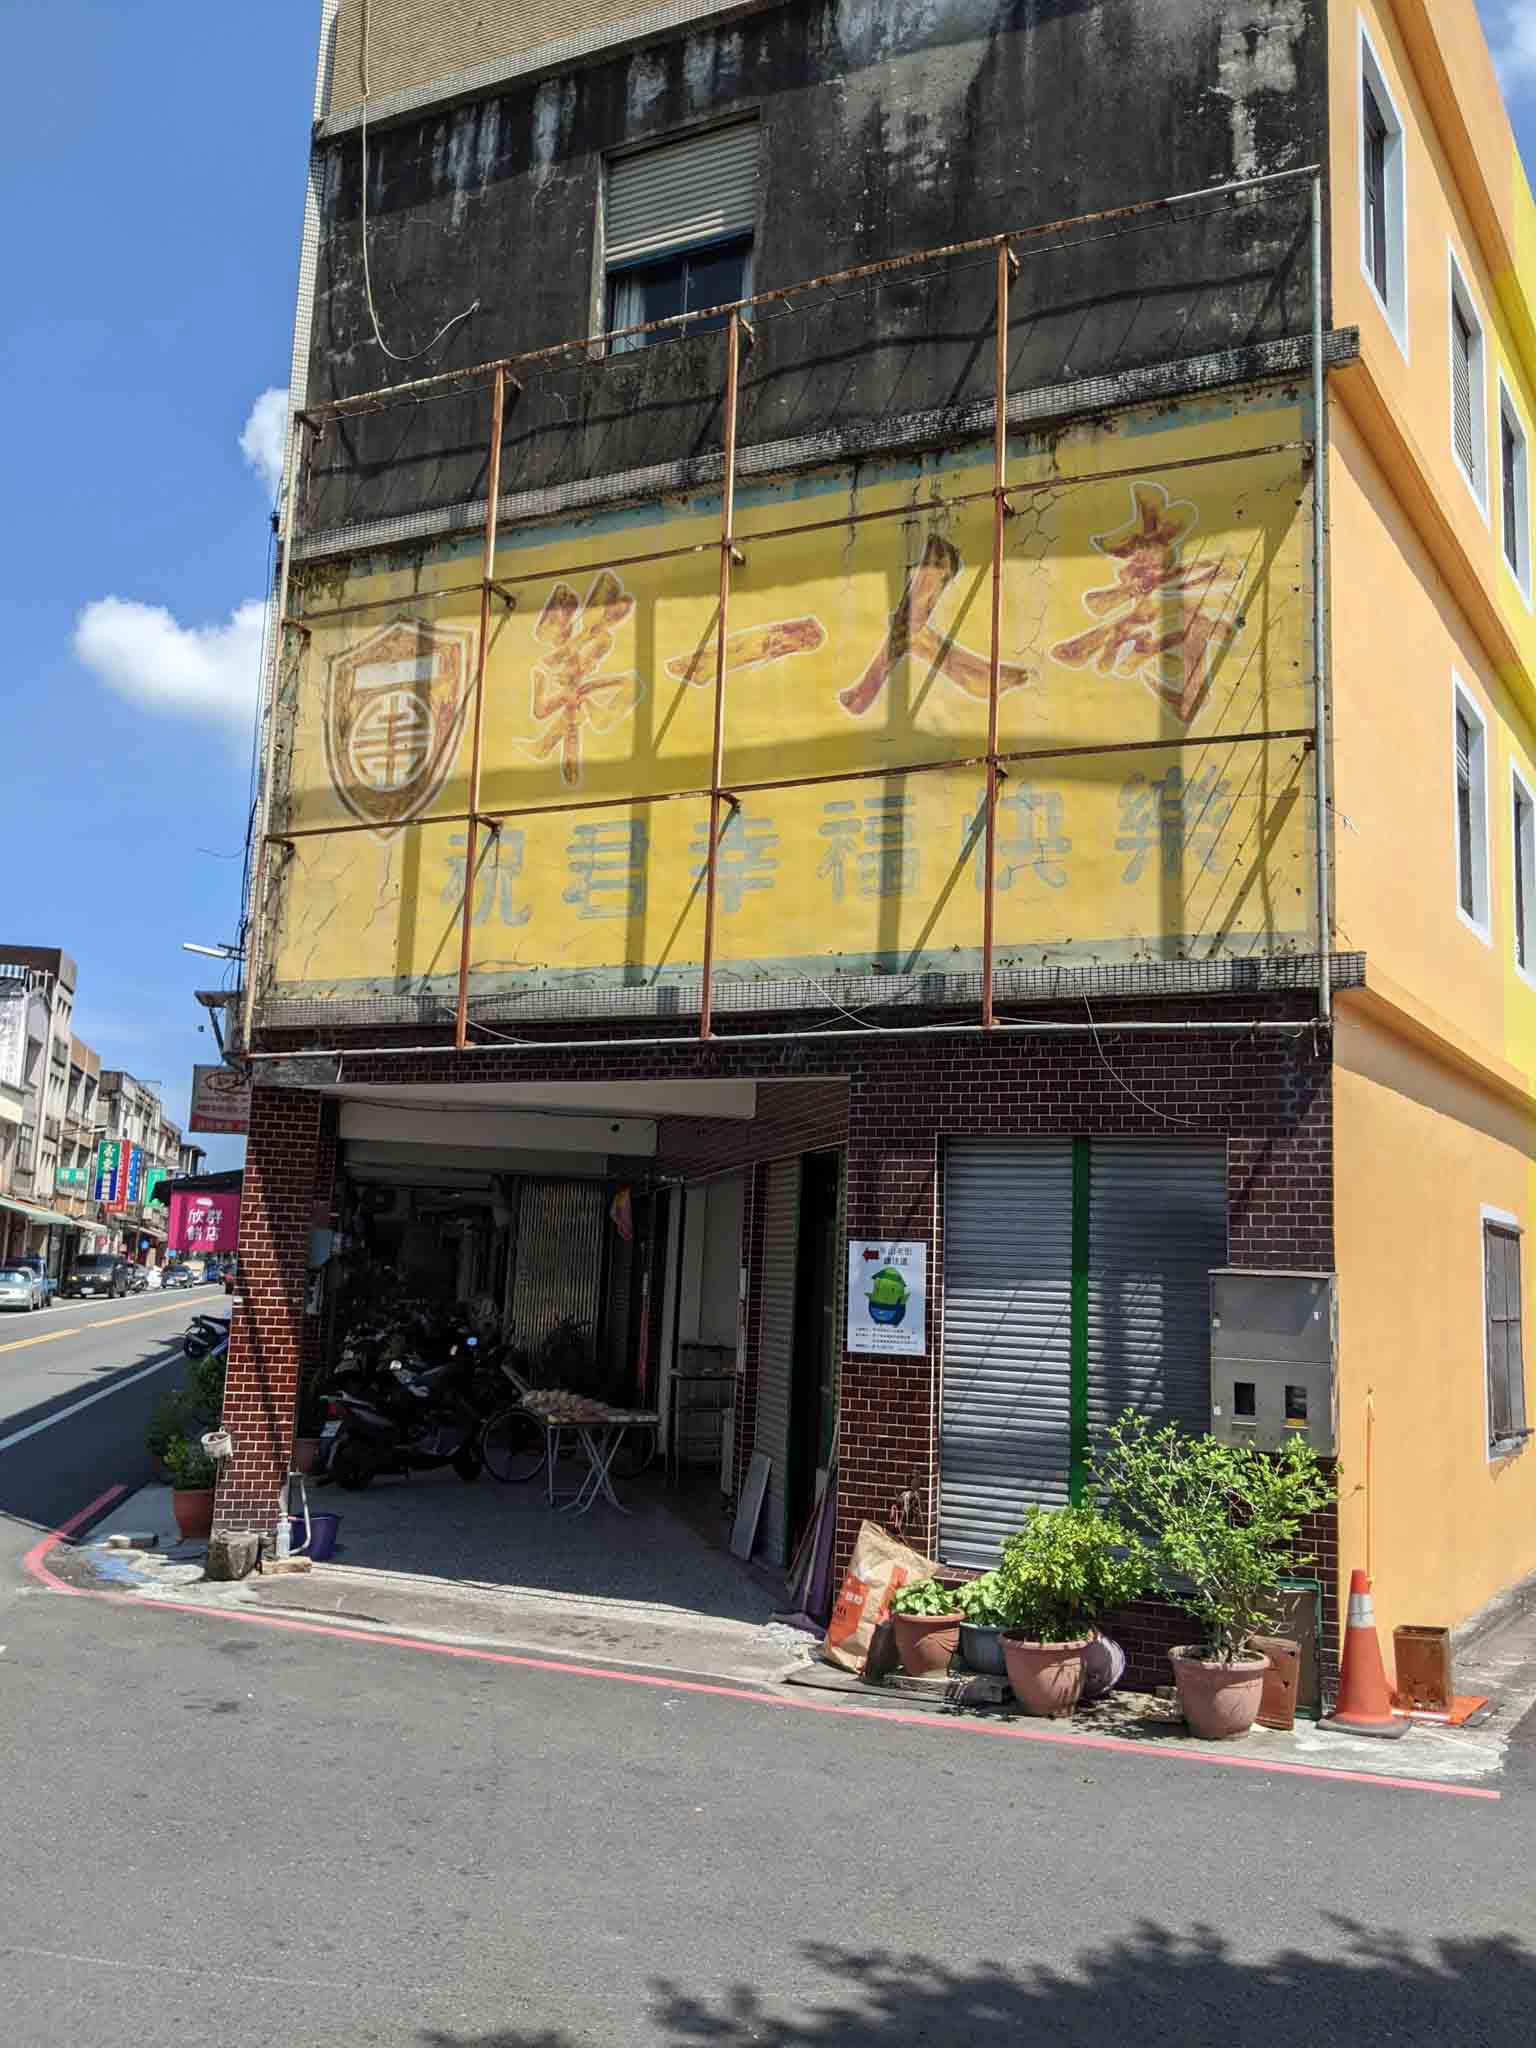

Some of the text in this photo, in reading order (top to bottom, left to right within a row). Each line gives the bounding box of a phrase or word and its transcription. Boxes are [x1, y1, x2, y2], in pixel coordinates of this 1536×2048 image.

[511, 480, 1246, 786] 第一人壽
[439, 763, 1233, 928] 祝君幸福快樂
